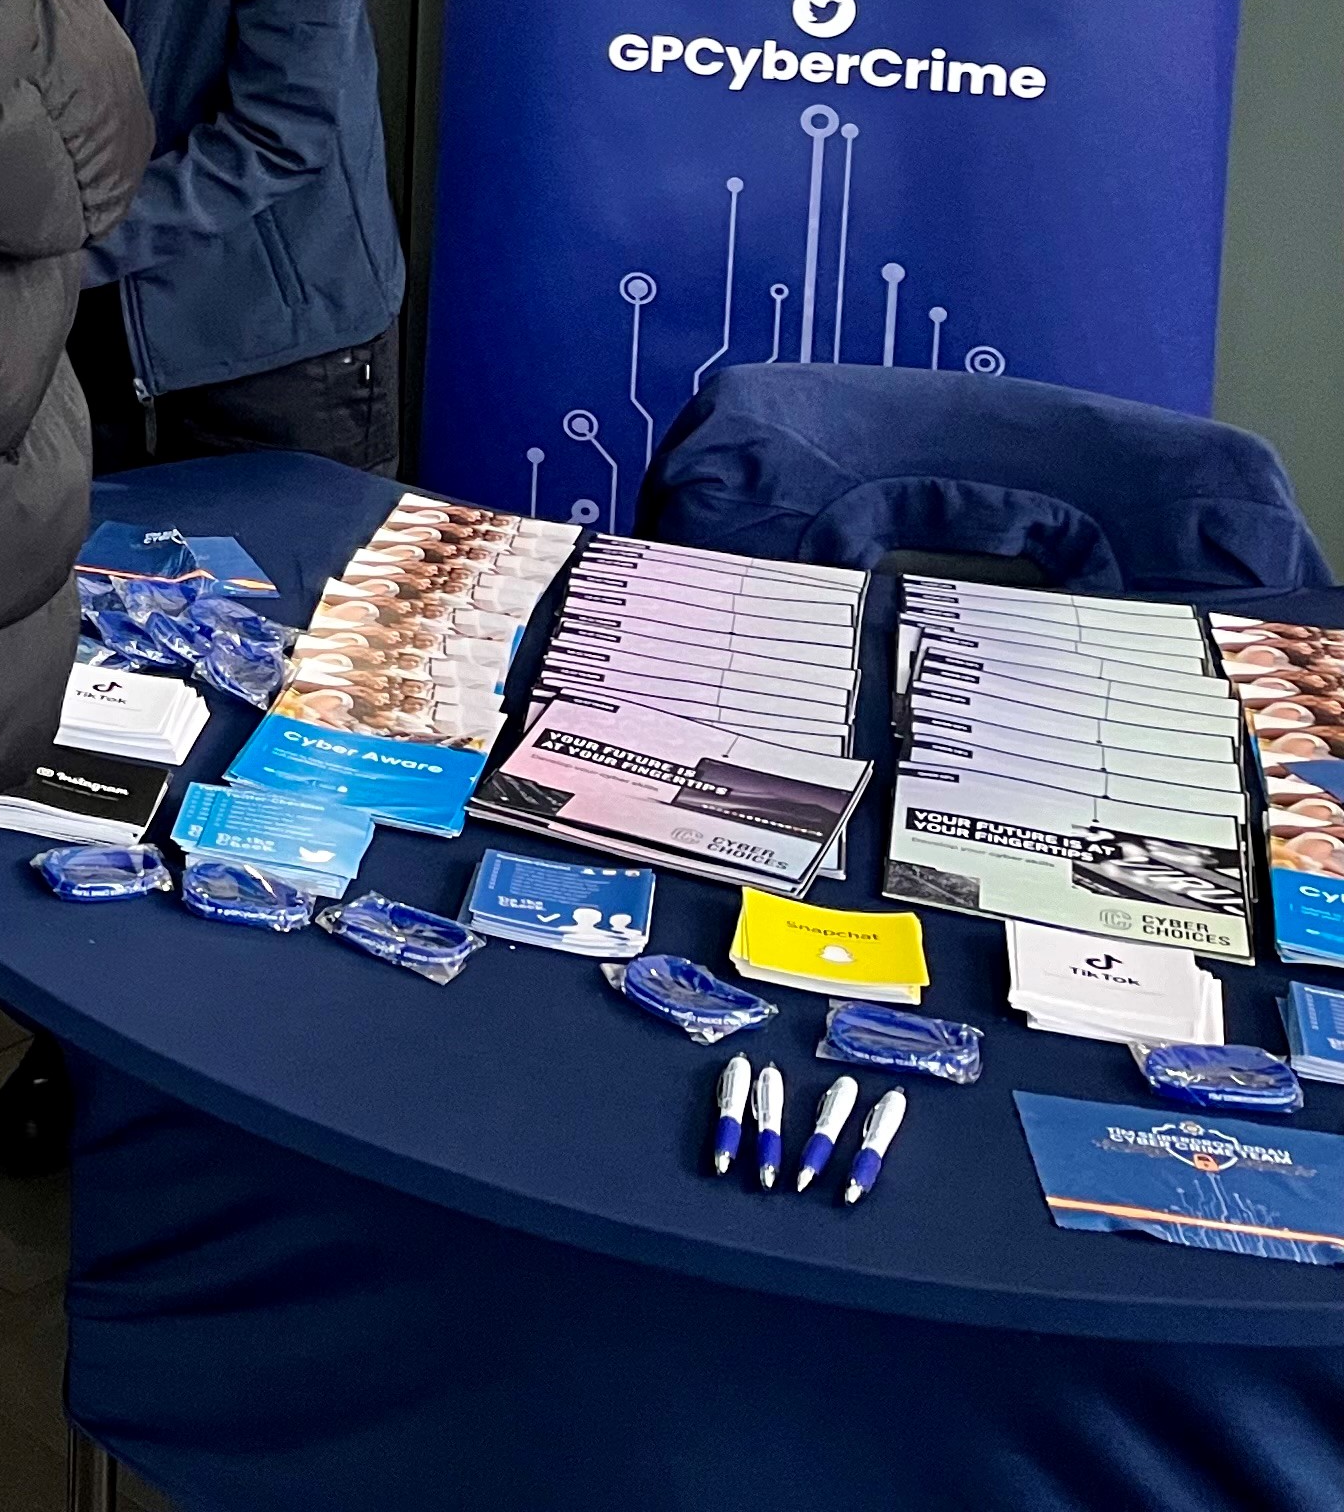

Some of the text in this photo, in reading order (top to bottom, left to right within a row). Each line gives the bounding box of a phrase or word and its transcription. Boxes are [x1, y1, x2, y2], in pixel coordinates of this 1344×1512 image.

[607, 33, 1048, 101] GPCyberCrime
[283, 730, 359, 757] Cyber
[362, 750, 444, 774] Aware
[541, 740, 729, 795] AT YOUR FINGERTIPS
[548, 731, 697, 778] YOUR FUTURE IS
[56, 771, 130, 796] Instagram
[712, 836, 775, 859] CYBER
[914, 810, 1116, 856] YOUR FUTURE IS AT
[914, 820, 1094, 863] YOUR FINGERTIPS
[708, 844, 789, 870] CHOICES
[786, 920, 879, 940] Snapchat
[1143, 914, 1209, 933] CYBER
[1143, 925, 1231, 947] CHOICES
